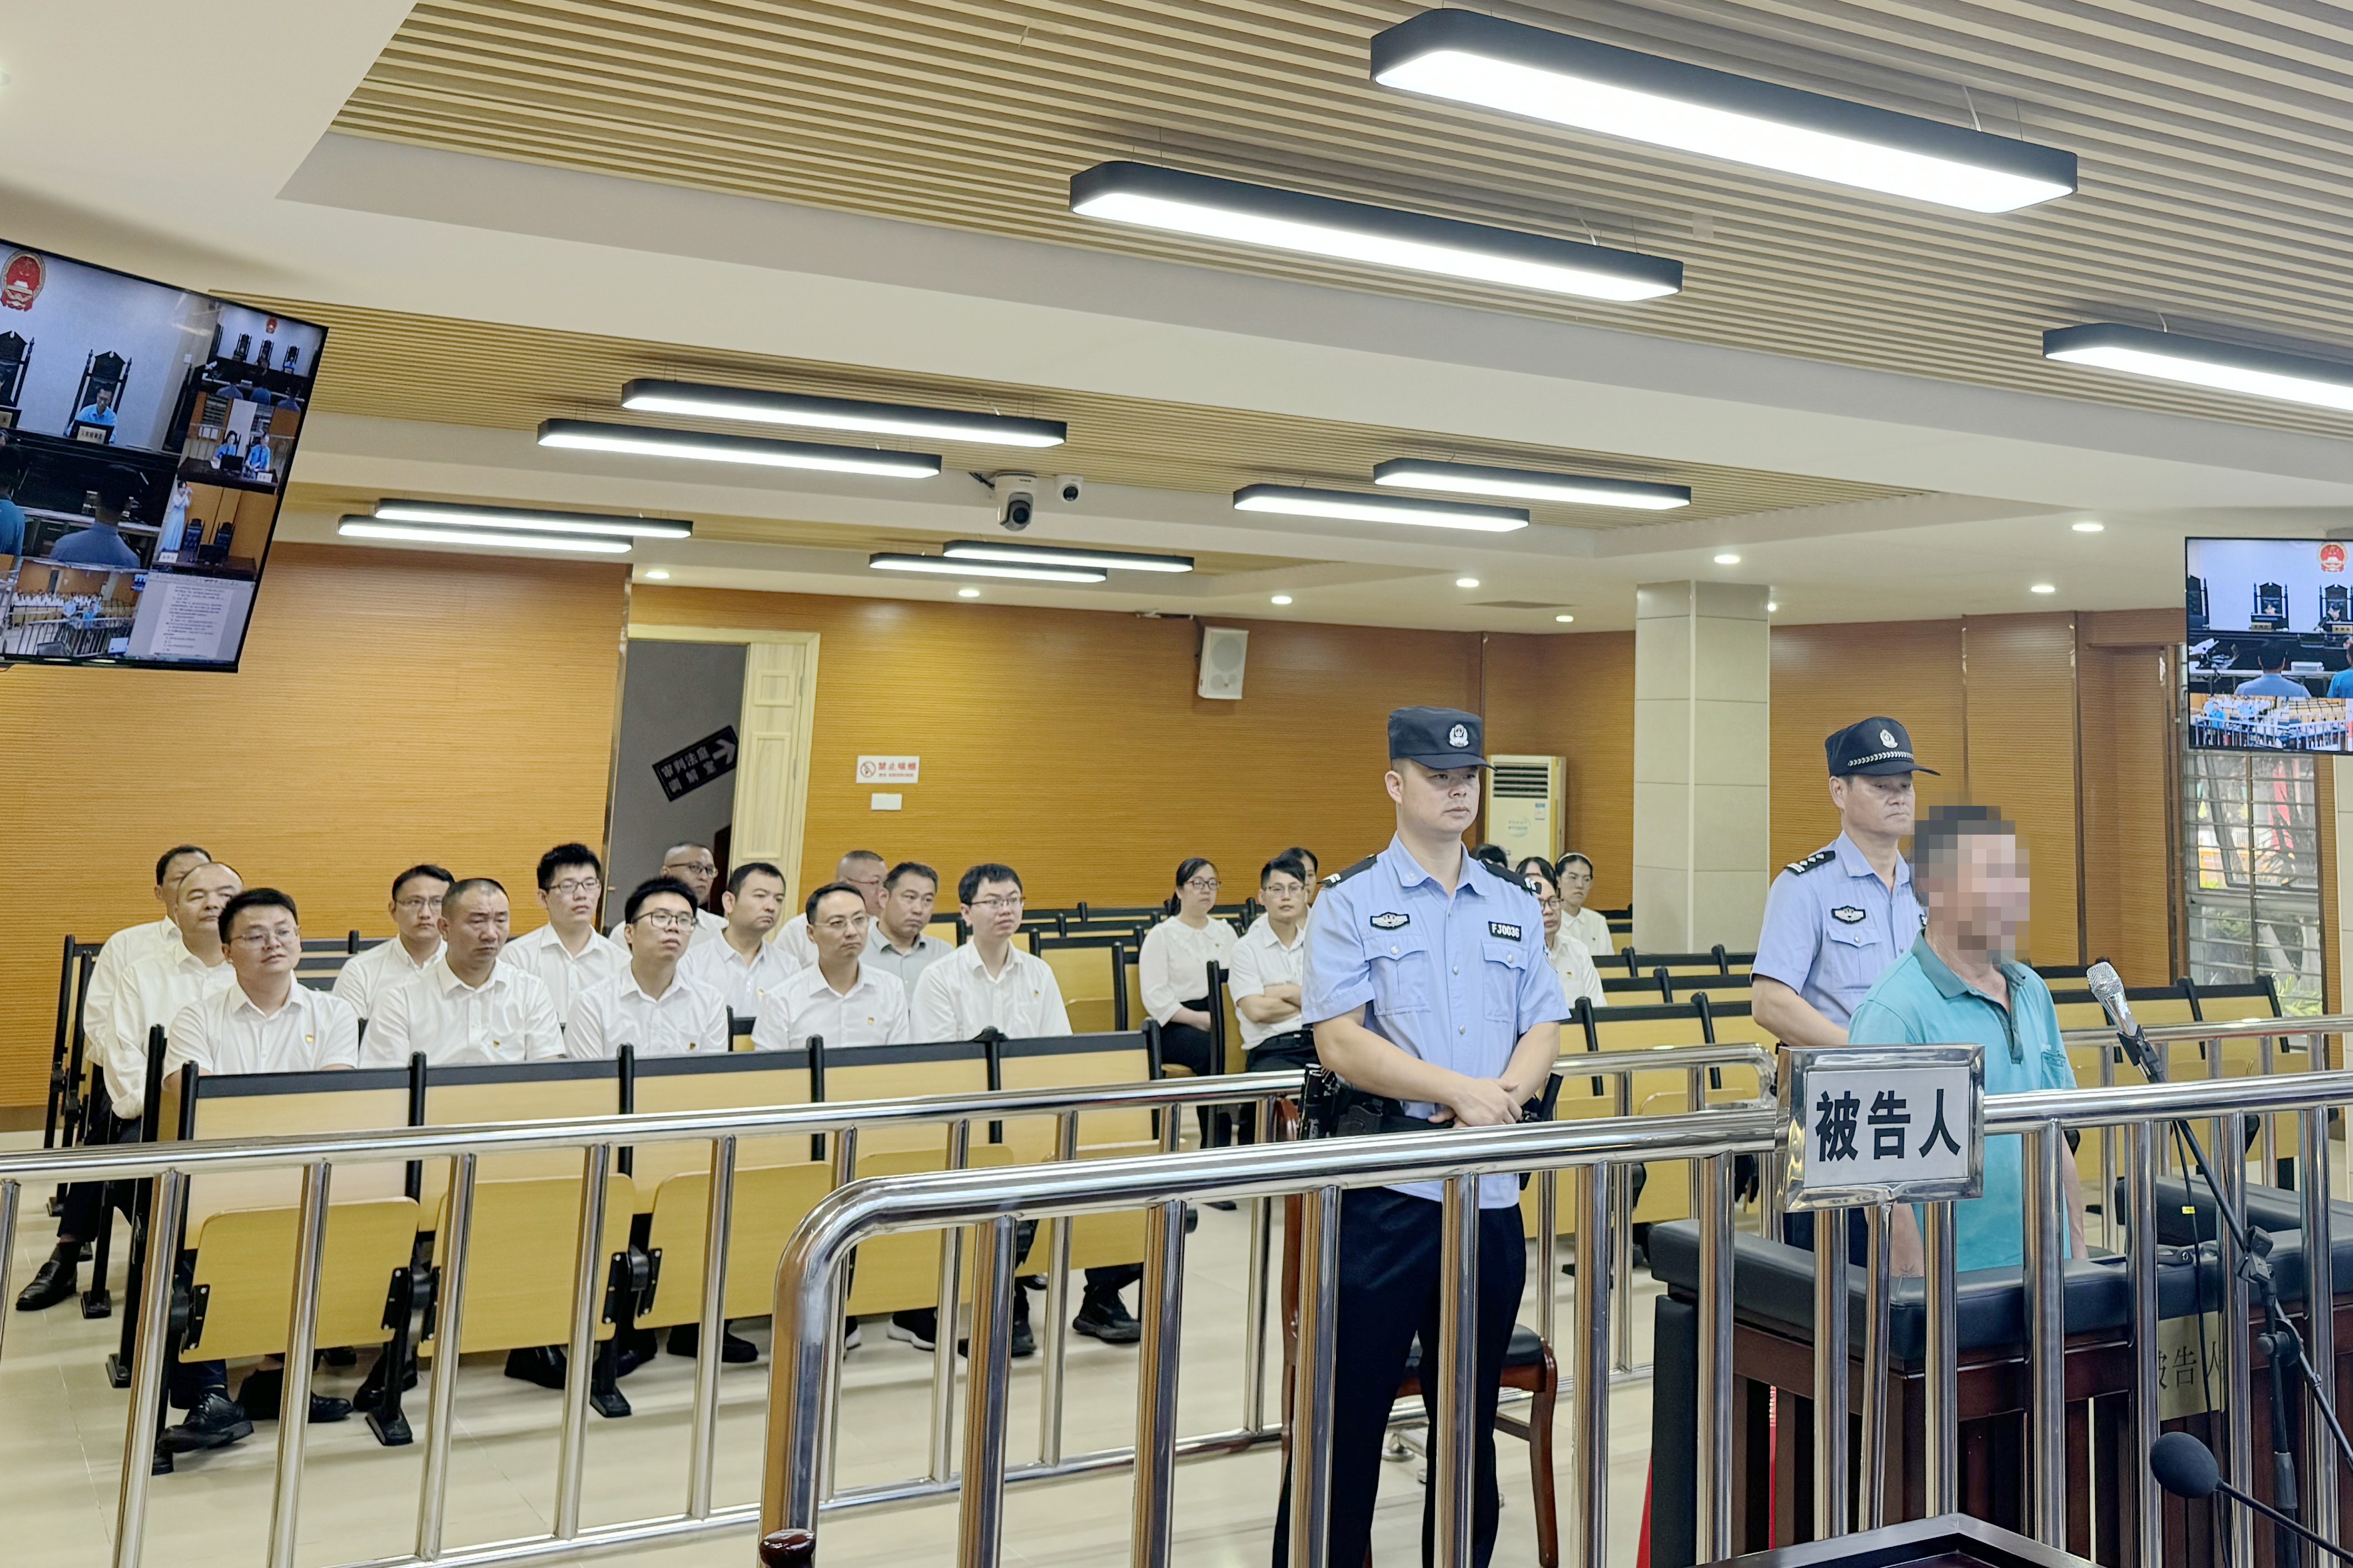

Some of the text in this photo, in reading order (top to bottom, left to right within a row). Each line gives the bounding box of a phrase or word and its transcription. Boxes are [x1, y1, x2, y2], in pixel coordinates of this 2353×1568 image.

[661, 746, 710, 778] 审判法庭
[1492, 923, 1520, 938] FJ0036
[1815, 1088, 1961, 1162] 被告人
